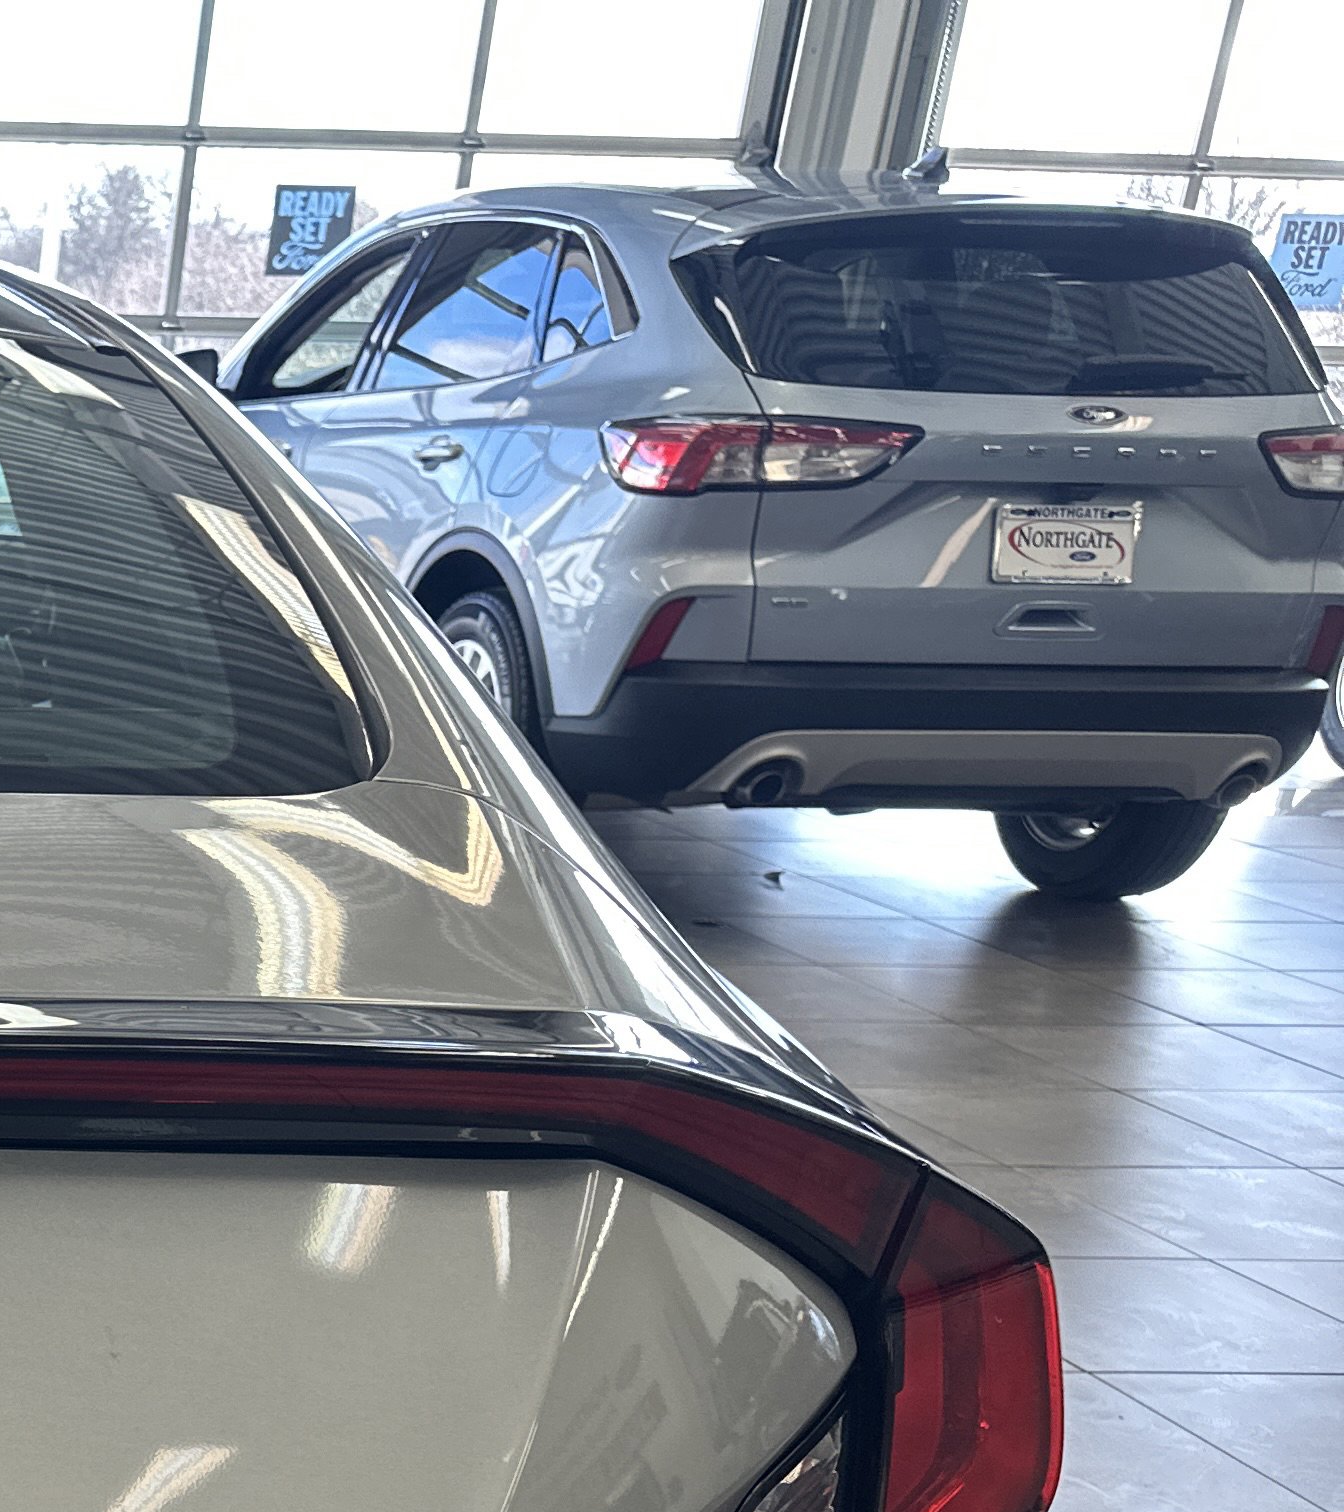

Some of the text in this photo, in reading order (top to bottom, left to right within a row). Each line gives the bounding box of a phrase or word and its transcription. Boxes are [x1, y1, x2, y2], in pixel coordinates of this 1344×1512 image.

[278, 190, 350, 218] READY
[289, 217, 331, 243] SET
[1291, 246, 1330, 270] SET
[1281, 270, 1337, 297] Ford
[1035, 507, 1108, 518] NORTHGATE
[1018, 527, 1115, 549] NORTHGATE
